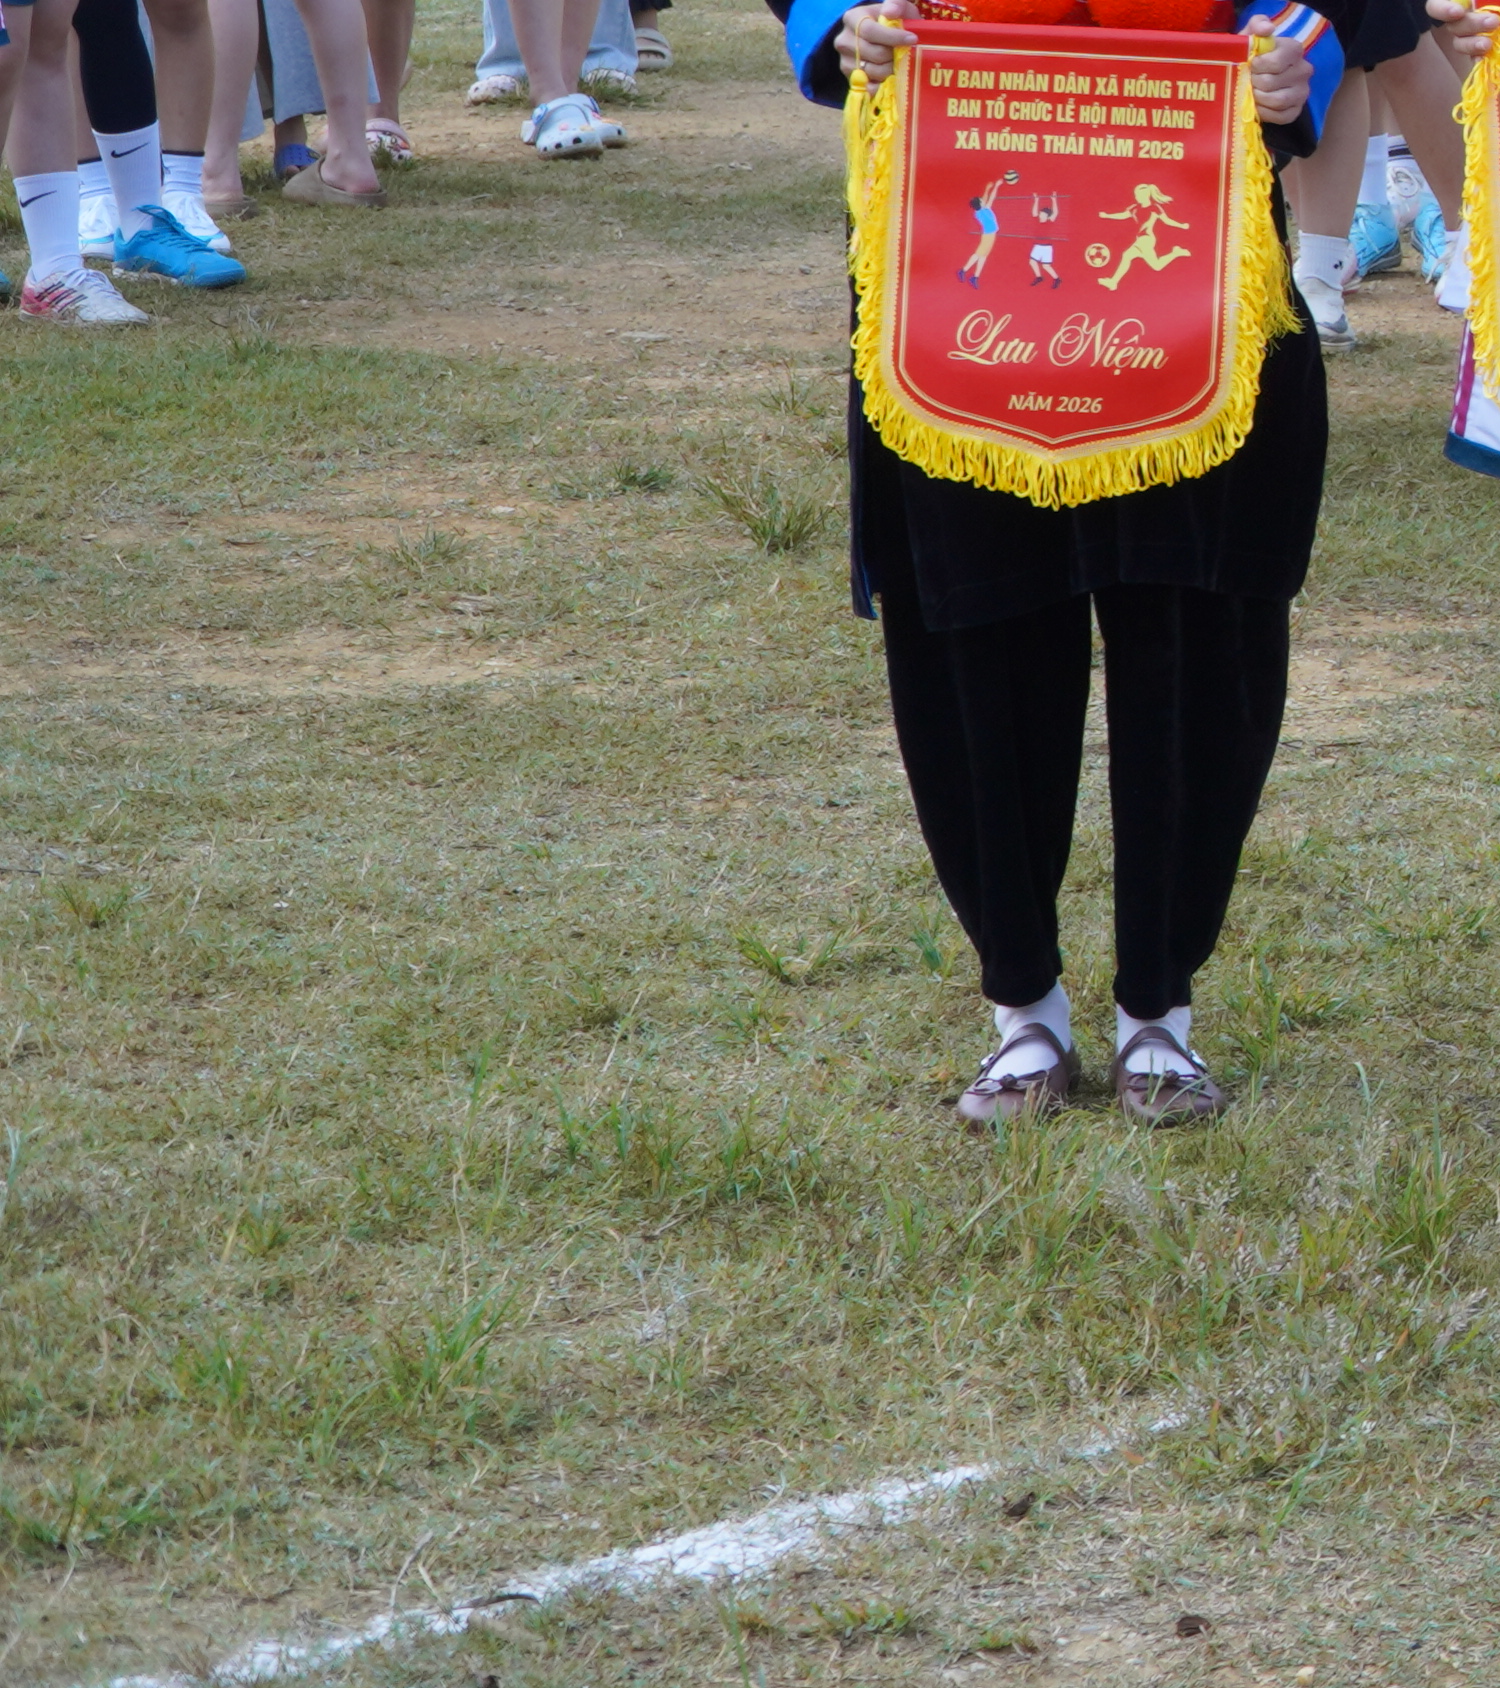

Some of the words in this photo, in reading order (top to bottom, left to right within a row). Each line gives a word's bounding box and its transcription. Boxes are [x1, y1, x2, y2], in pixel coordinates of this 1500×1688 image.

[929, 62, 954, 87] ỦY
[957, 69, 995, 90] BAN
[998, 69, 1050, 93] NHÂN
[1053, 71, 1091, 95] DÂN
[1094, 74, 1119, 97] XÃ
[1123, 73, 1172, 99] HỒNG
[1176, 78, 1216, 102] THÁI
[946, 97, 982, 119] BAN
[985, 93, 1007, 120] TỔ
[1008, 98, 1053, 122] CHỨC
[1055, 97, 1076, 123] LỄ
[1078, 101, 1107, 129] HỘI
[1110, 103, 1148, 127] MÙA
[1151, 105, 1195, 130] VÀNG
[954, 127, 981, 150] XÃ
[985, 126, 1038, 153] HỒNG
[1042, 132, 1085, 155] THÁI
[1089, 134, 1134, 158] NĂM
[1137, 139, 1185, 161] 2026
[947, 308, 1039, 366] Lưu
[1048, 312, 1167, 376] Niệm
[1007, 391, 1053, 412] NĂM
[1055, 396, 1104, 414] 2026
